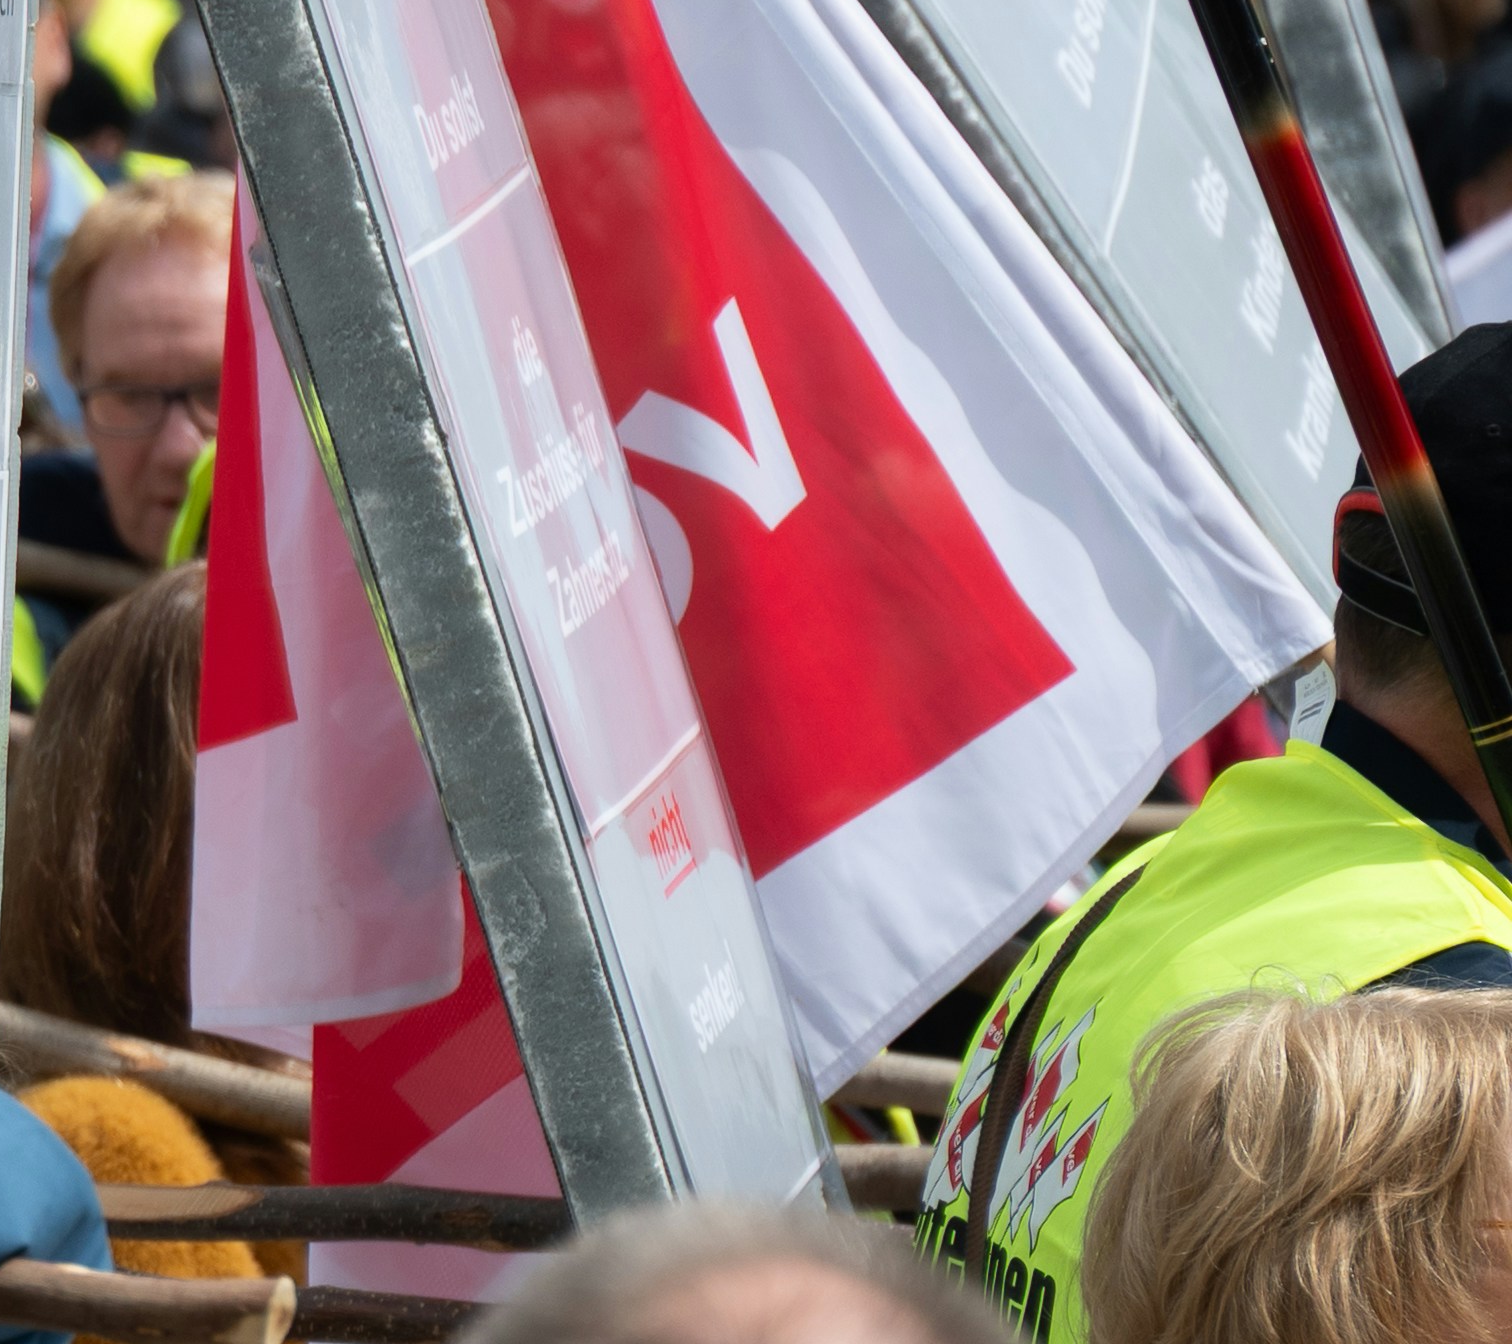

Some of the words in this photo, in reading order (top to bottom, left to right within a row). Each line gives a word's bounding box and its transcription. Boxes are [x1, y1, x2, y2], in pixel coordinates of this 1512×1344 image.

[1057, 33, 1097, 110] Du
[413, 103, 451, 172] Du
[441, 68, 486, 155] sollst
[1191, 154, 1230, 240] das
[511, 315, 543, 388] die
[497, 430, 588, 539] Zuschüsse
[573, 401, 605, 472] für
[648, 789, 692, 881] nicht
